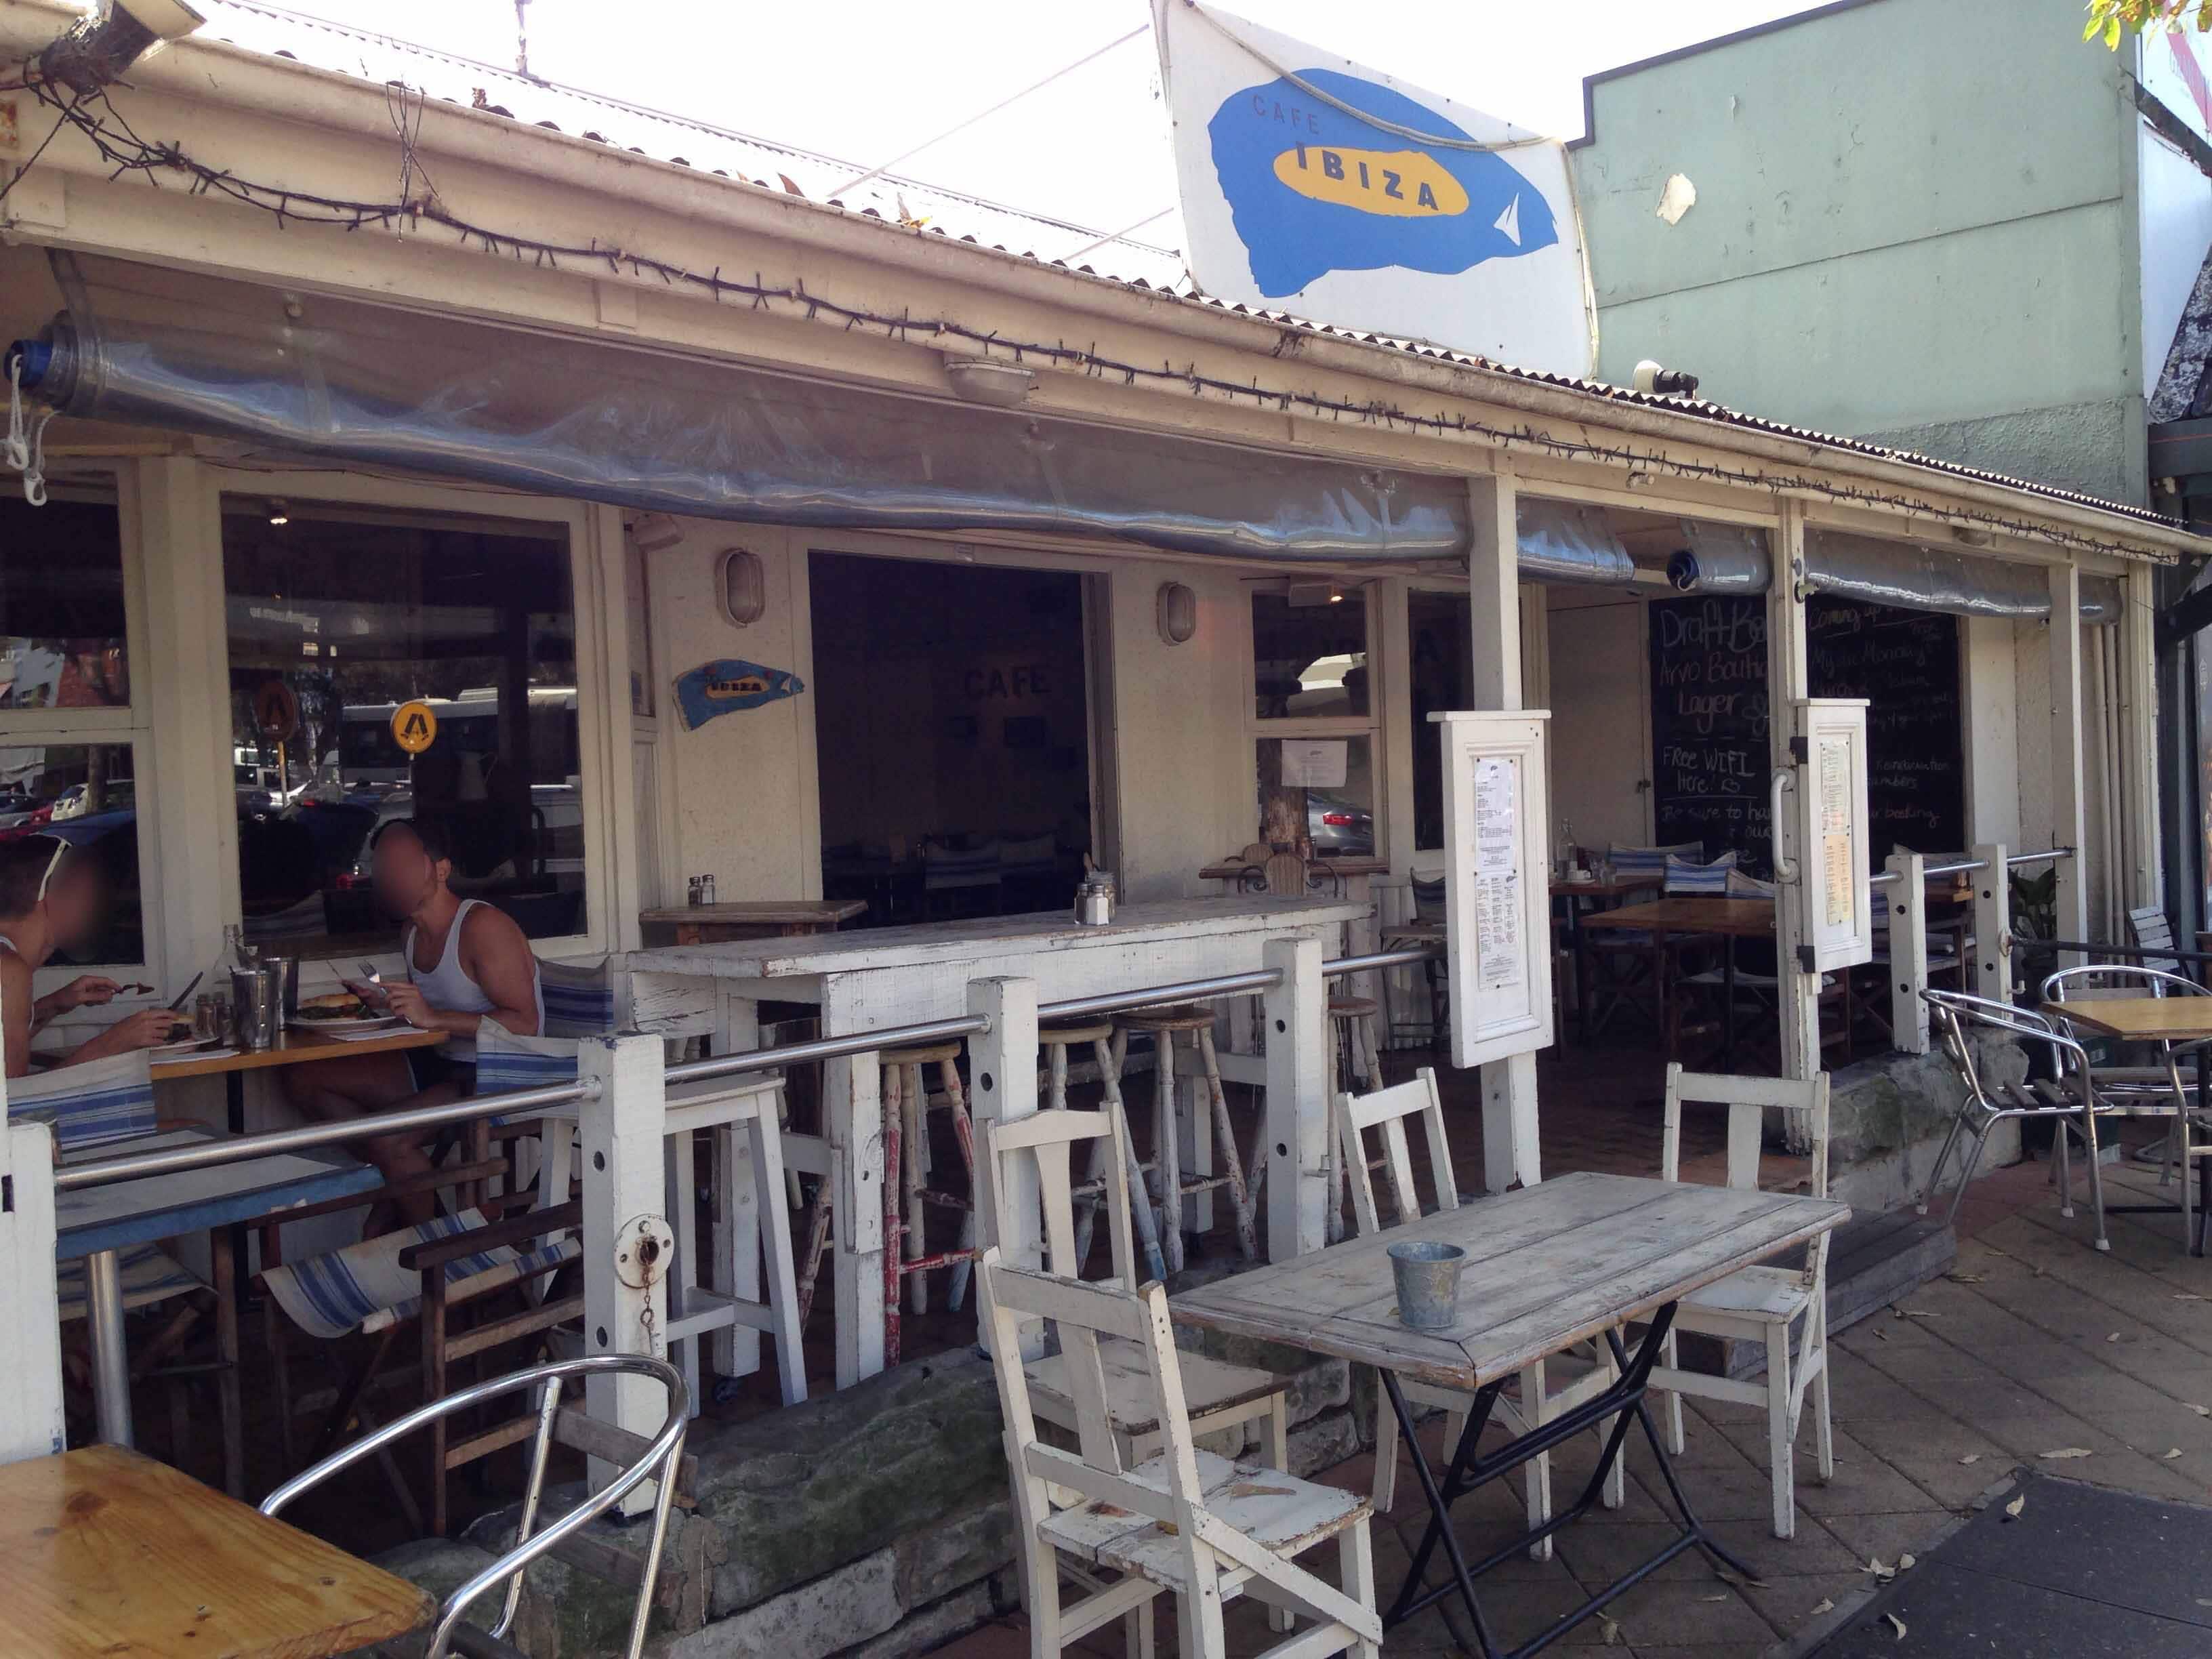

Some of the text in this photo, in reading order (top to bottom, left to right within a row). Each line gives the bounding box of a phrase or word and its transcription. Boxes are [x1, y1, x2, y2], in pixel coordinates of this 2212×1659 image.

[1252, 94, 1319, 136] CAFE
[1295, 141, 1439, 211] IBIZA
[965, 665, 1052, 699] CAFE
[1679, 688, 1744, 734] Lager
